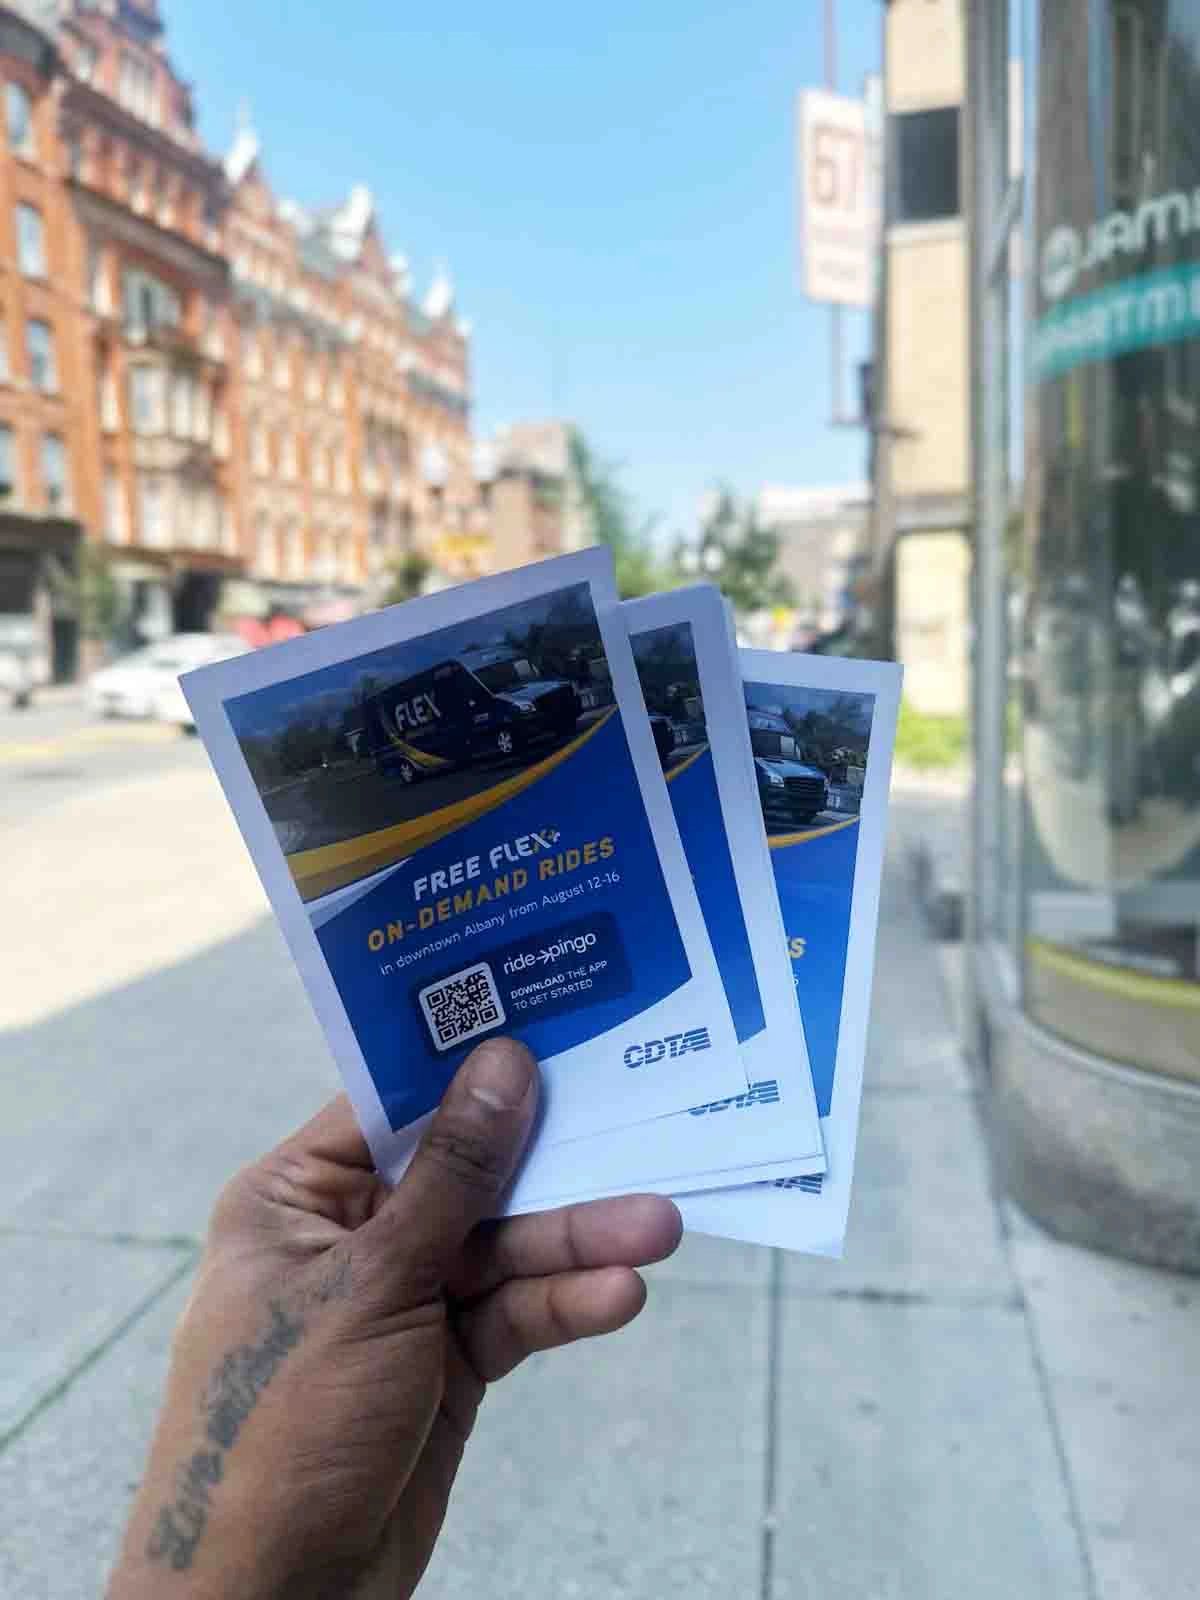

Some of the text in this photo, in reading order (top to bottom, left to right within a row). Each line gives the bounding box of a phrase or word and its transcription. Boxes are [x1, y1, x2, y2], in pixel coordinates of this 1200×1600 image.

[394, 689, 441, 731] FLEX
[367, 836, 616, 952] ON-DEMAND RIDES
[413, 855, 481, 900] FREE
[380, 871, 621, 977] in downtown Albany from August 12-16
[510, 960, 608, 1000] DOWNLOAD THE APP
[512, 978, 593, 1010] TO GET STARTED
[623, 1026, 712, 1069] CDTA
